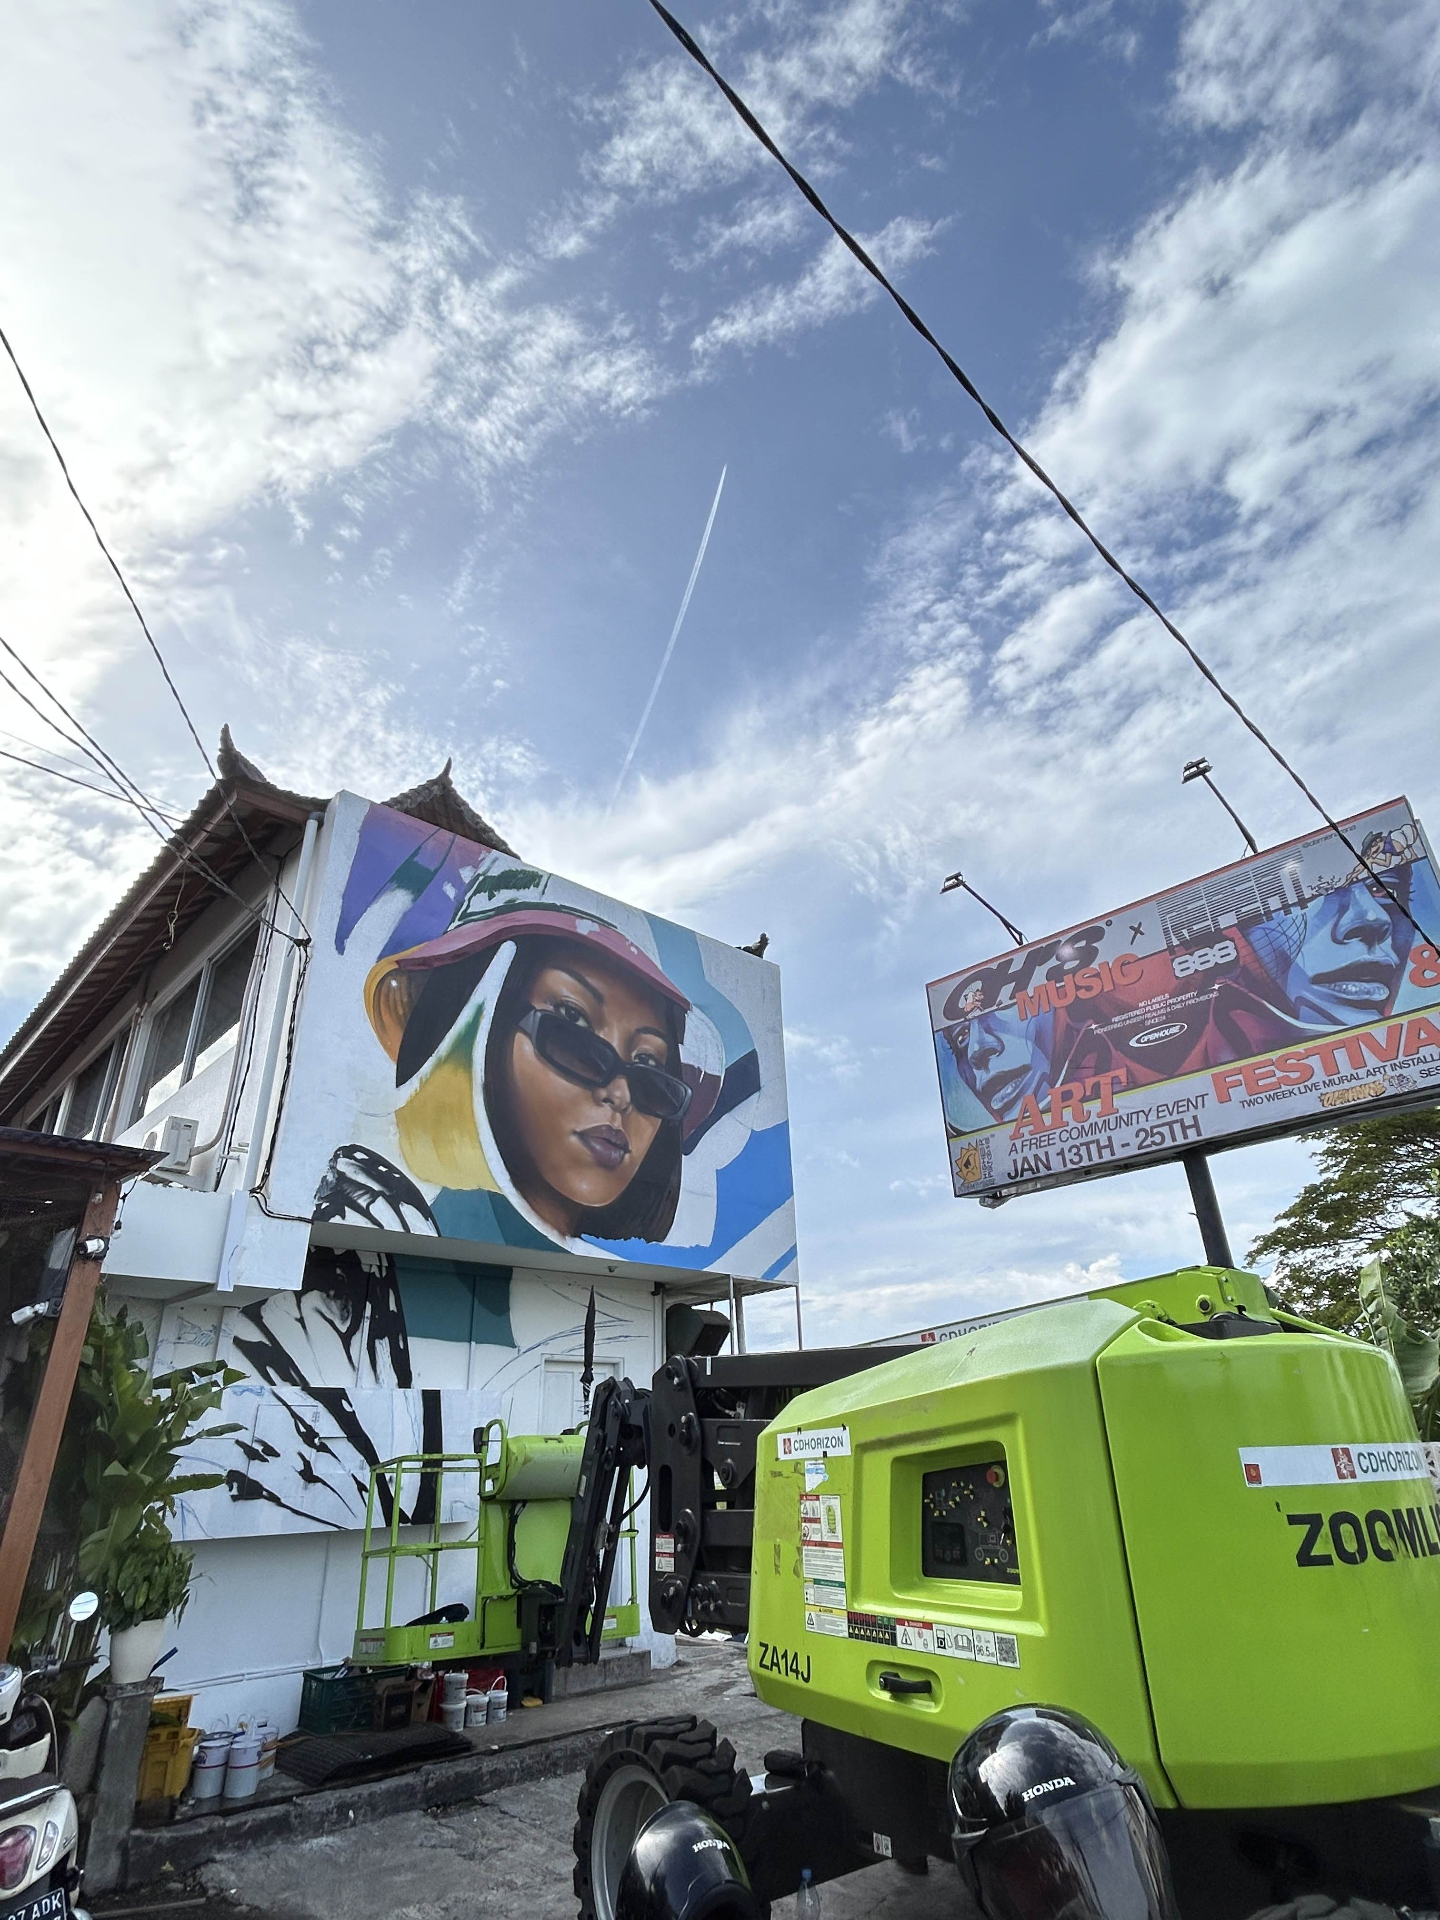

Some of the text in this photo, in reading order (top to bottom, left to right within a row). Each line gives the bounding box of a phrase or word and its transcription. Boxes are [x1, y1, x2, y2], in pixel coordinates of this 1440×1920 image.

[1172, 940, 1237, 979] 888
[1408, 943, 1440, 988] &
[1015, 952, 1145, 1021] MUSIC
[1138, 993, 1170, 1008] NO LABELS
[1112, 991, 1198, 1023] REGISTERED PUBLIC PROPERTY
[1123, 1015, 1145, 1026] UNSEEN
[1144, 1008, 1167, 1020] REALMS
[1171, 1002, 1186, 1012] DAILY
[1185, 991, 1219, 1006] PROVISIONS
[1140, 1025, 1181, 1044] OPENHOUSE
[1239, 1052, 1440, 1109] TWO WEEK LIVE MURAL ART INSTALL
[1008, 1067, 1129, 1141] ART
[1008, 1092, 1210, 1157] A FREE COMMUNITY EVENT
[978, 1138, 988, 1180] HIGHER
[1007, 1150, 1052, 1180] JAN
[1056, 1135, 1116, 1168] 13TH
[1135, 1115, 1203, 1151] 25TH
[793, 1435, 844, 1451] CDHORIZON
[1357, 1450, 1423, 1474] CDHORIZON
[1286, 1504, 1440, 1567] ZOOMLI
[758, 1641, 812, 1684] ZA14J
[1021, 1776, 1076, 1803] HONDA
[692, 1839, 731, 1853] HONDA
[32, 1892, 62, 1919] ADK
